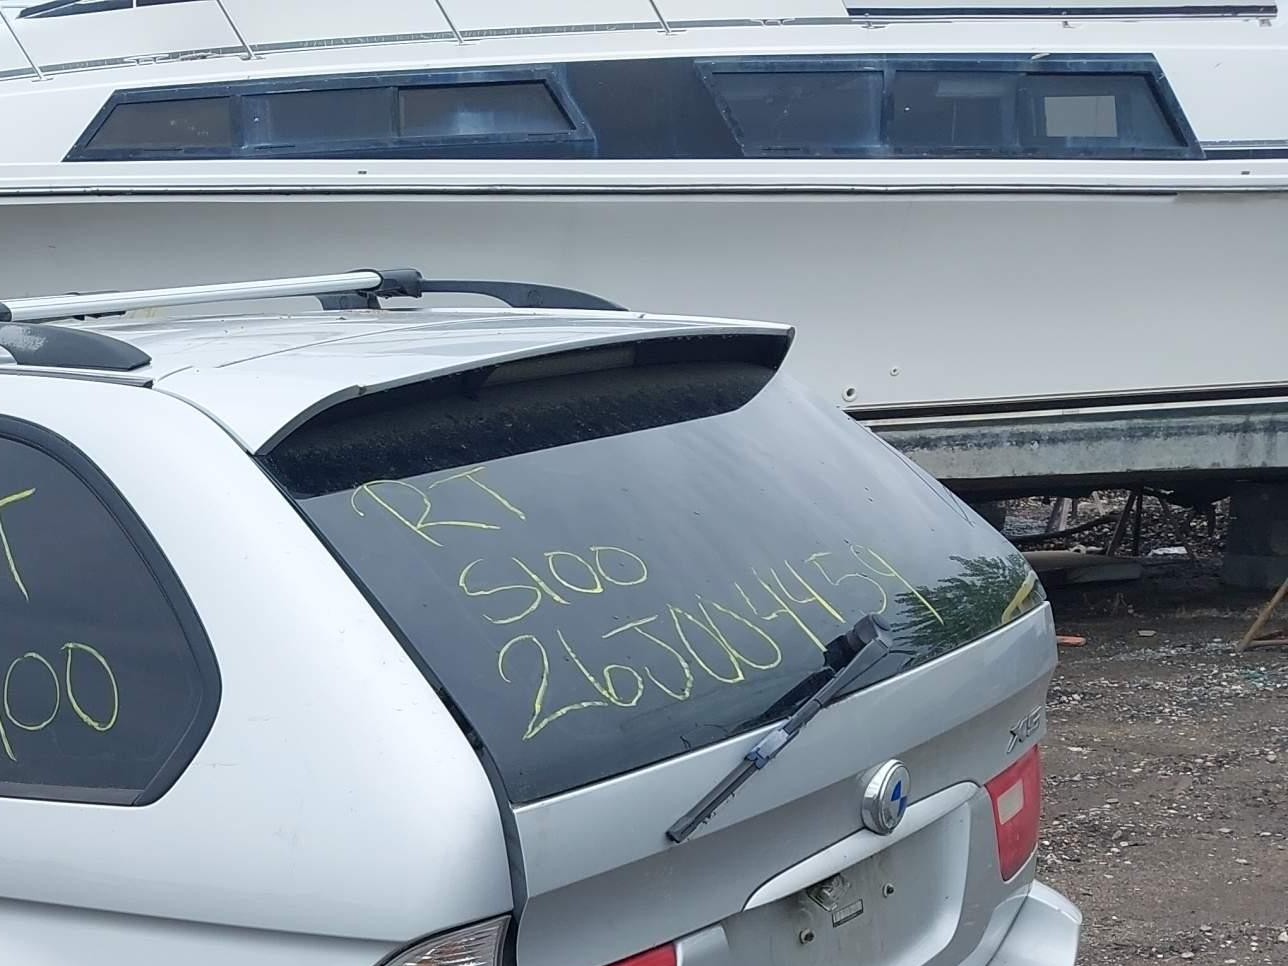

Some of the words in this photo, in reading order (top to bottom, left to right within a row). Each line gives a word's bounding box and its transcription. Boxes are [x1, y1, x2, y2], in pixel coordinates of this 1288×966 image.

[350, 466, 528, 548] RT
[458, 544, 650, 626] S100
[1007, 705, 1043, 755] X5
